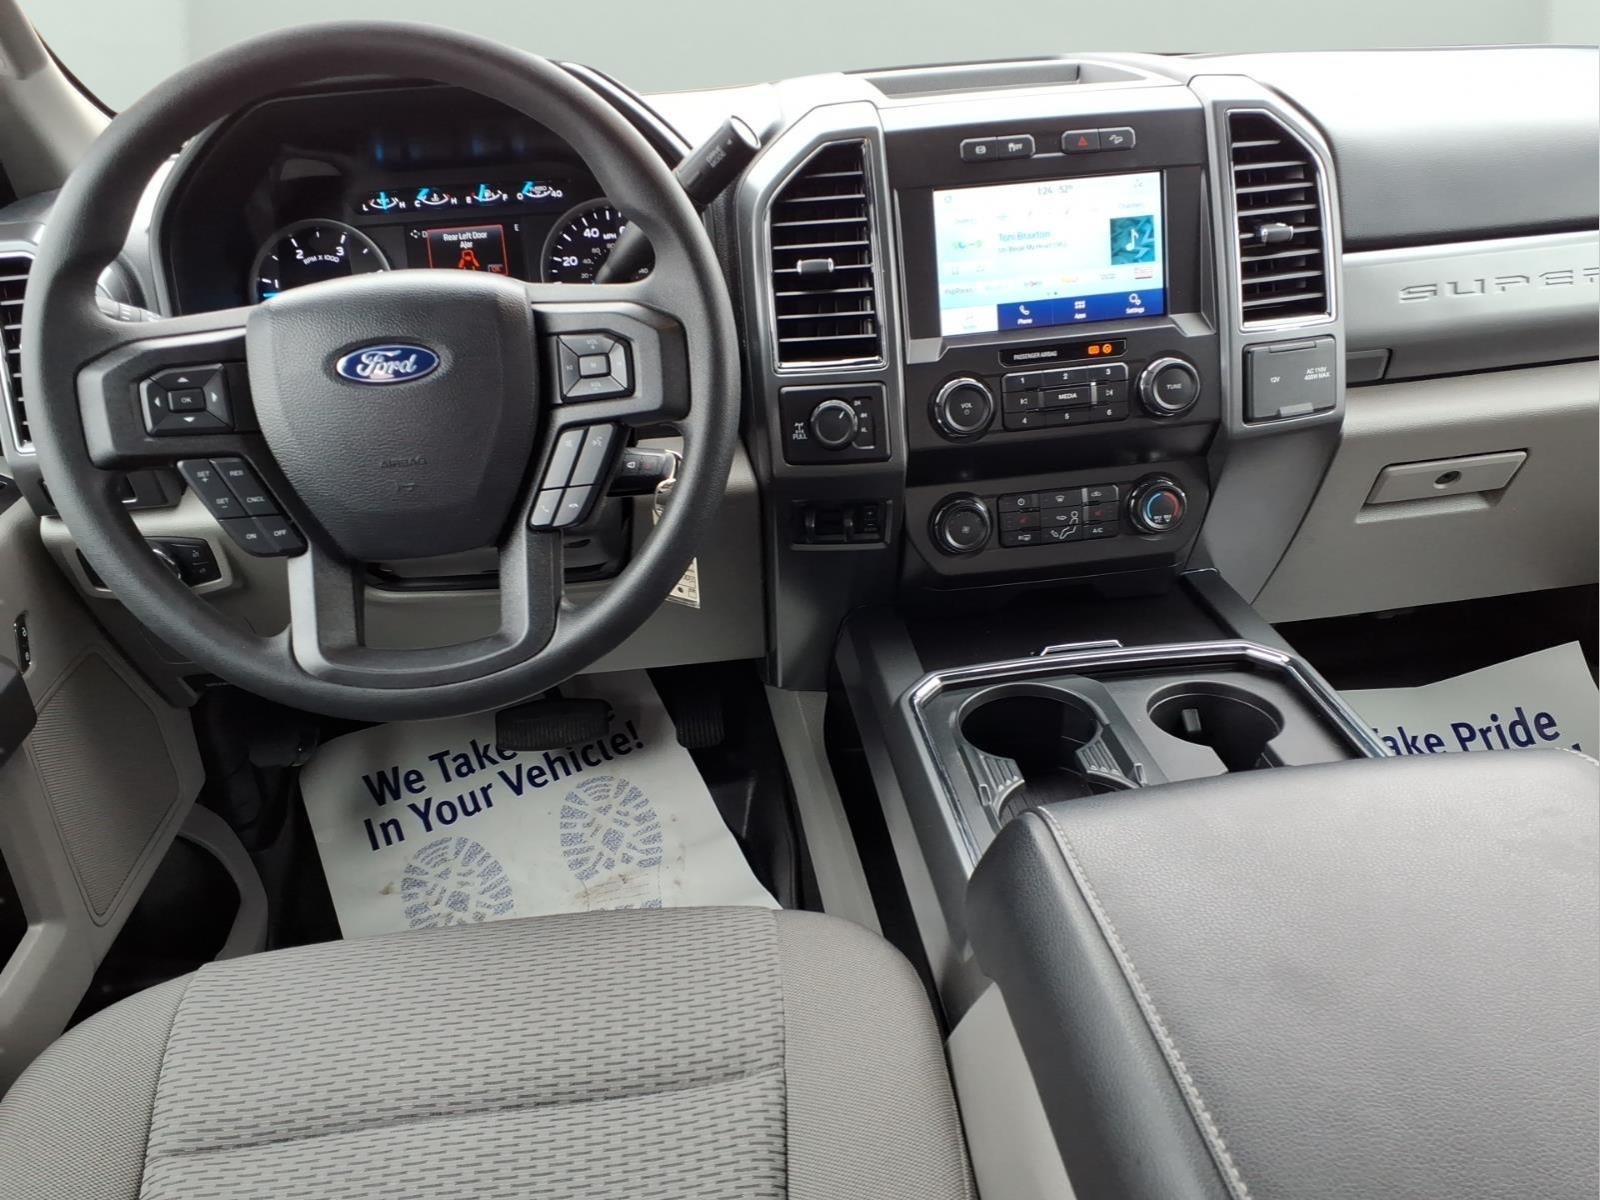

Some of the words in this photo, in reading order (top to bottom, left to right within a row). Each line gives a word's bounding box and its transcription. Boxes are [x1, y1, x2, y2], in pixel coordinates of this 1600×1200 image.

[551, 190, 563, 198] 40
[443, 233, 458, 241] Rear
[458, 232, 472, 240] Left
[472, 231, 488, 239] Door
[583, 228, 600, 238] 40
[295, 249, 304, 259] 2
[336, 246, 345, 256] 3
[303, 256, 317, 265] RPM
[324, 255, 340, 263] 1000
[562, 256, 578, 266] 20
[1125, 307, 1145, 315] Settings
[1013, 352, 1040, 360] PASSENGER
[356, 350, 418, 377] Ford
[1058, 392, 1077, 400] MEDIA
[274, 529, 287, 537] OFF
[1372, 726, 1446, 756] ake
[1450, 706, 1561, 752] Pride
[361, 765, 427, 807] We
[428, 738, 518, 783] Take
[363, 818, 405, 851] In
[406, 783, 493, 832] Your
[497, 720, 644, 796] Vehicle!
